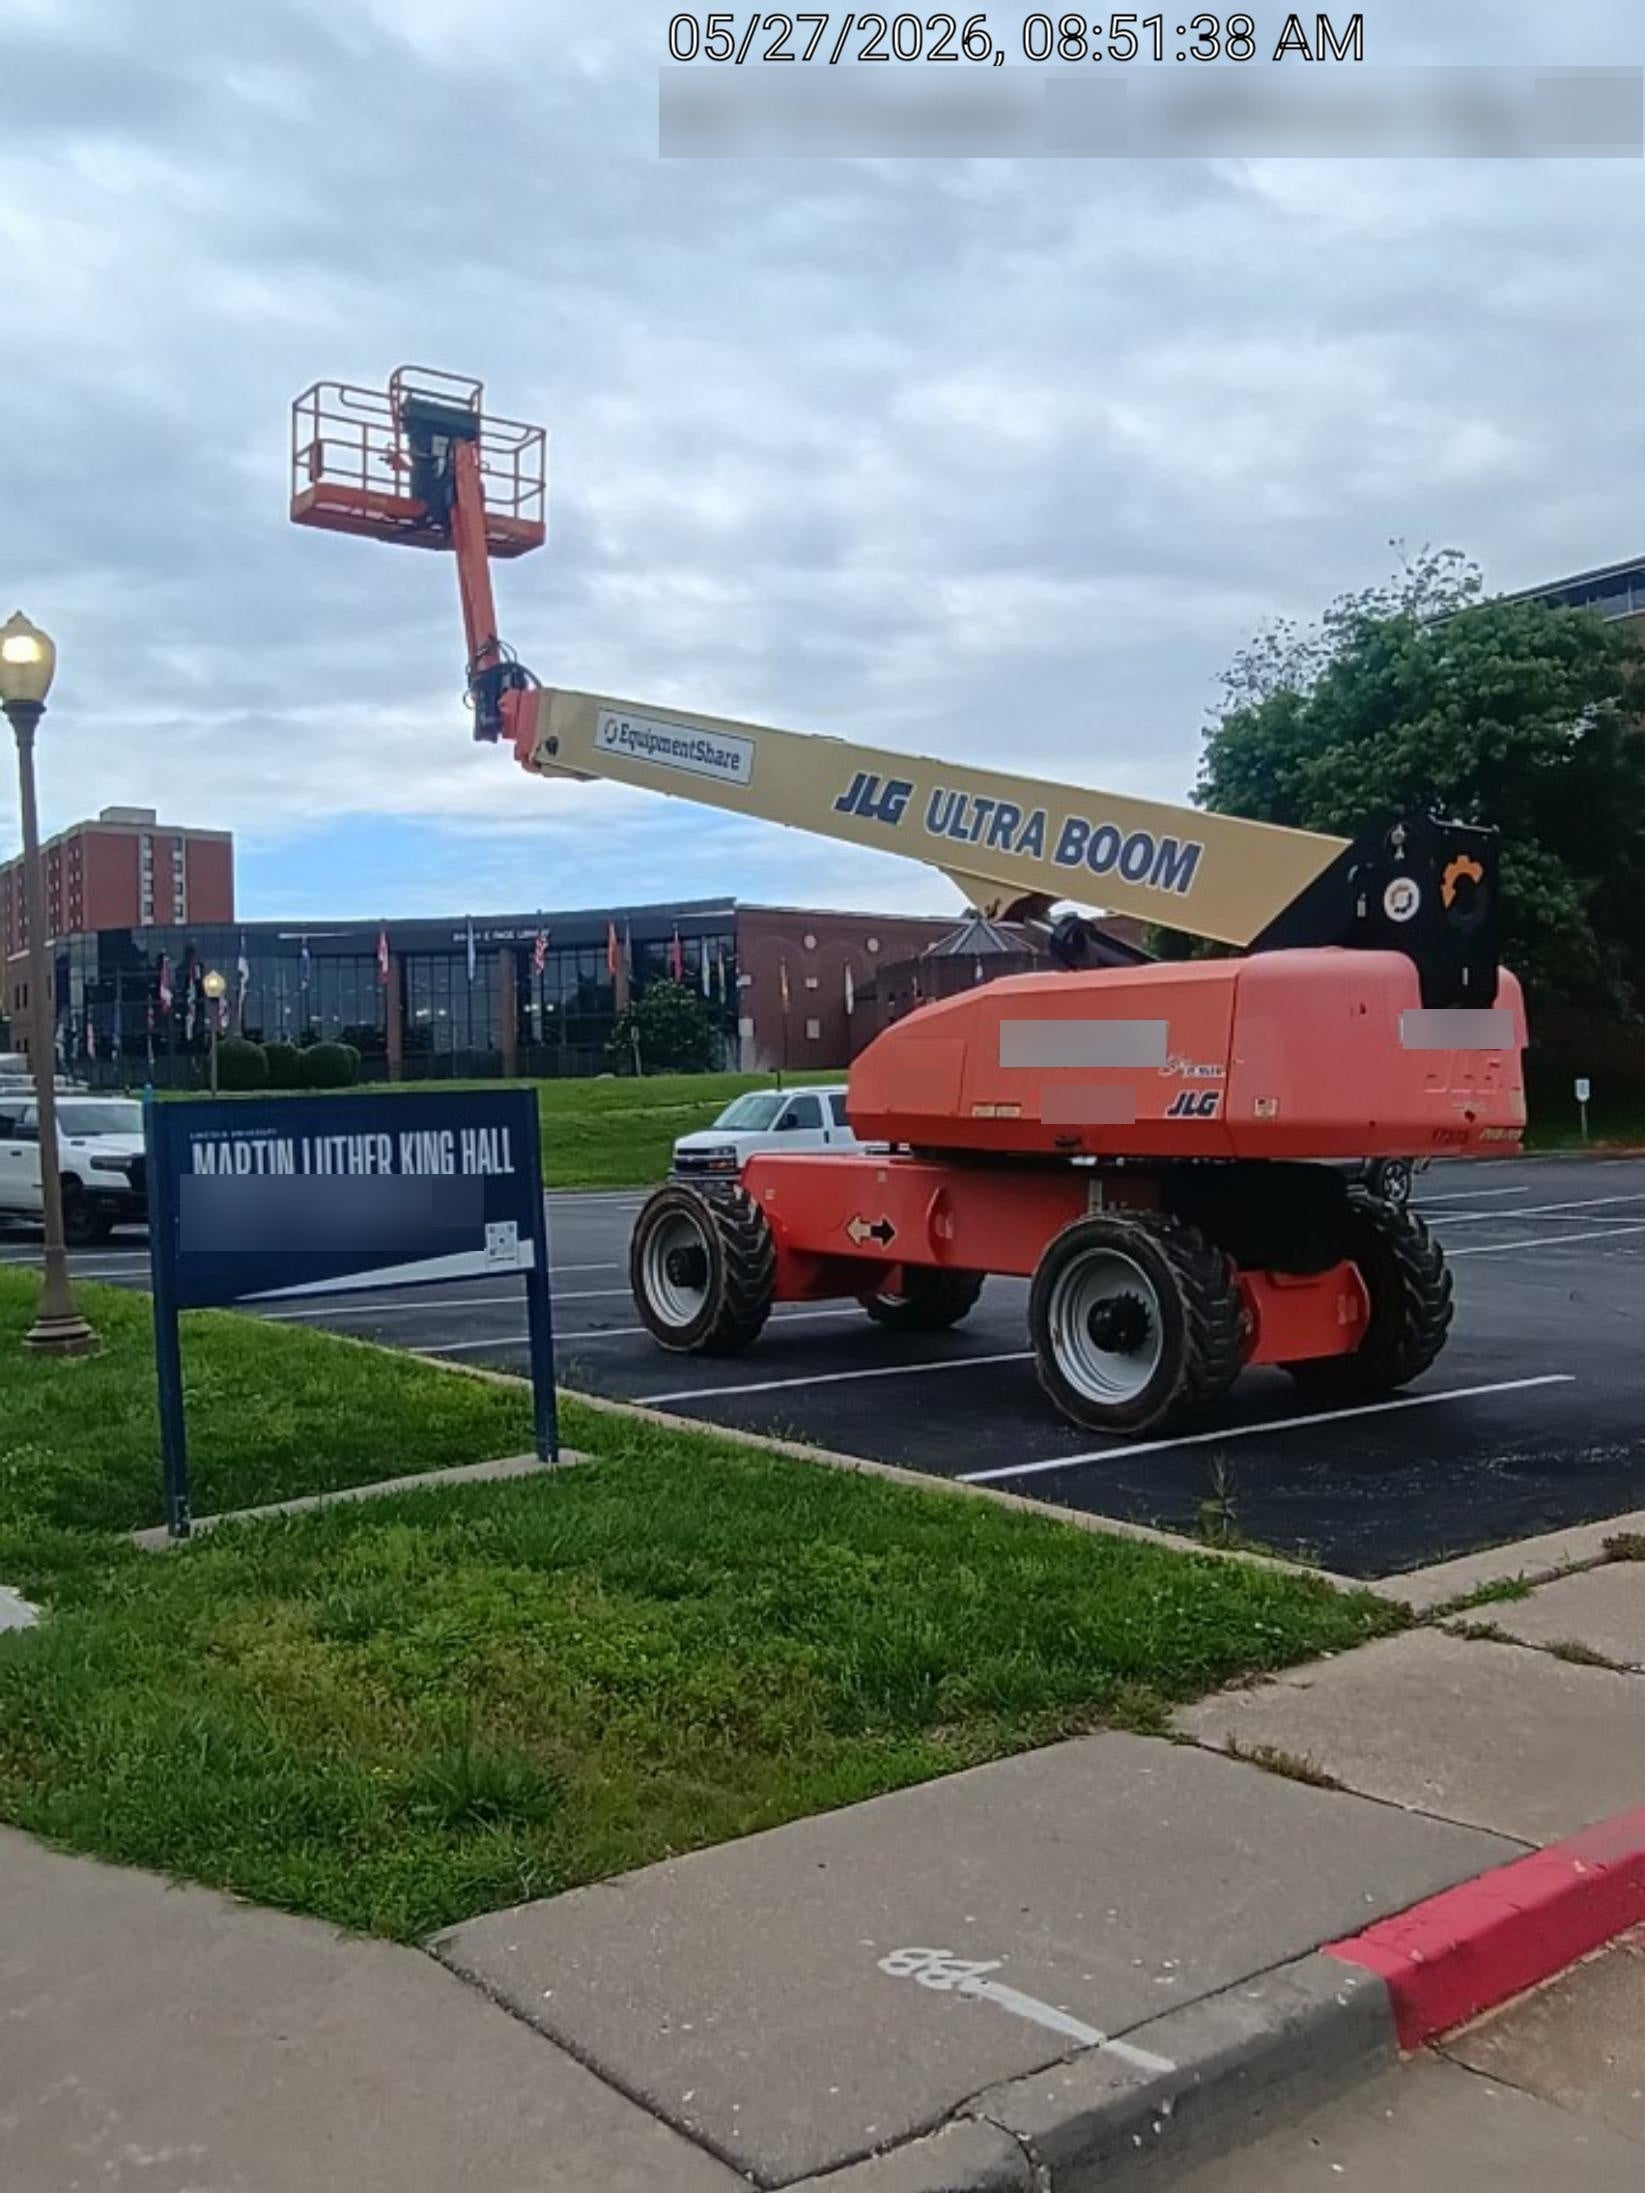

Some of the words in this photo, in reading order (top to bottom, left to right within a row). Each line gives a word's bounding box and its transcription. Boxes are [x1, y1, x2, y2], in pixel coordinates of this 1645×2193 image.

[618, 722, 741, 771] EquipmentShare
[834, 772, 914, 826] JLG
[925, 788, 1046, 860] ULTRA
[1054, 815, 1203, 894] BOOM
[1165, 1090, 1221, 1119] JLG
[398, 1130, 455, 1174] KING
[460, 1126, 515, 1174] HALL
